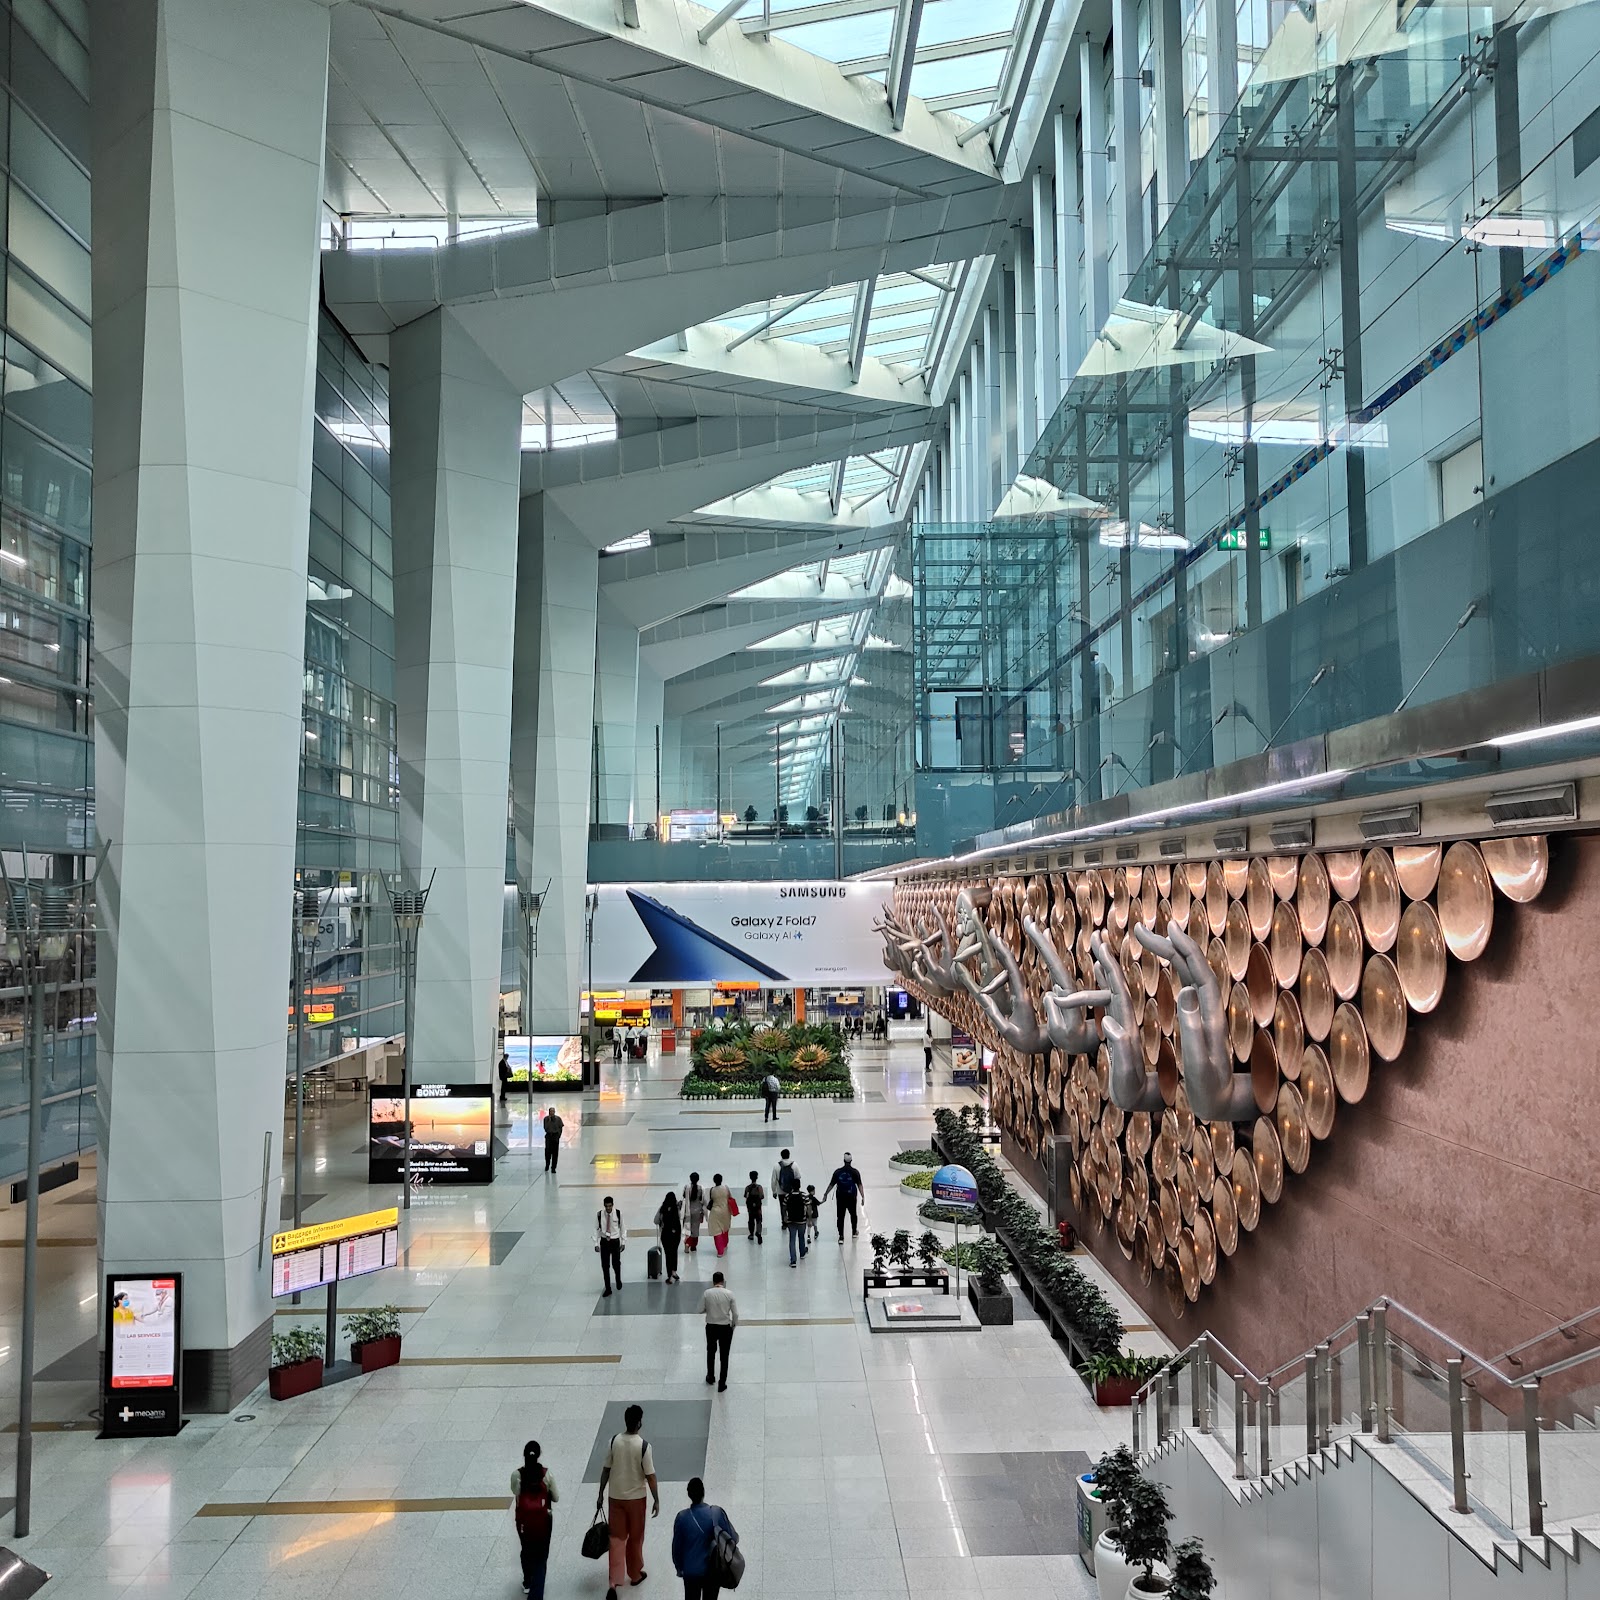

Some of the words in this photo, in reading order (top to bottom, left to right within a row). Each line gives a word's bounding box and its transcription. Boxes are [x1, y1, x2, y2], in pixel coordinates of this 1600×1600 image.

[780, 887, 846, 898] SAMSUNG
[731, 916, 775, 928] Galaxy
[776, 916, 783, 926] Z
[785, 915, 817, 926] Fold7
[744, 931, 780, 941] Galaxy
[782, 931, 792, 940] AI
[416, 1089, 451, 1097] BONVOY
[950, 1191, 972, 1199] AIRPORT
[287, 1230, 312, 1240] Baggage
